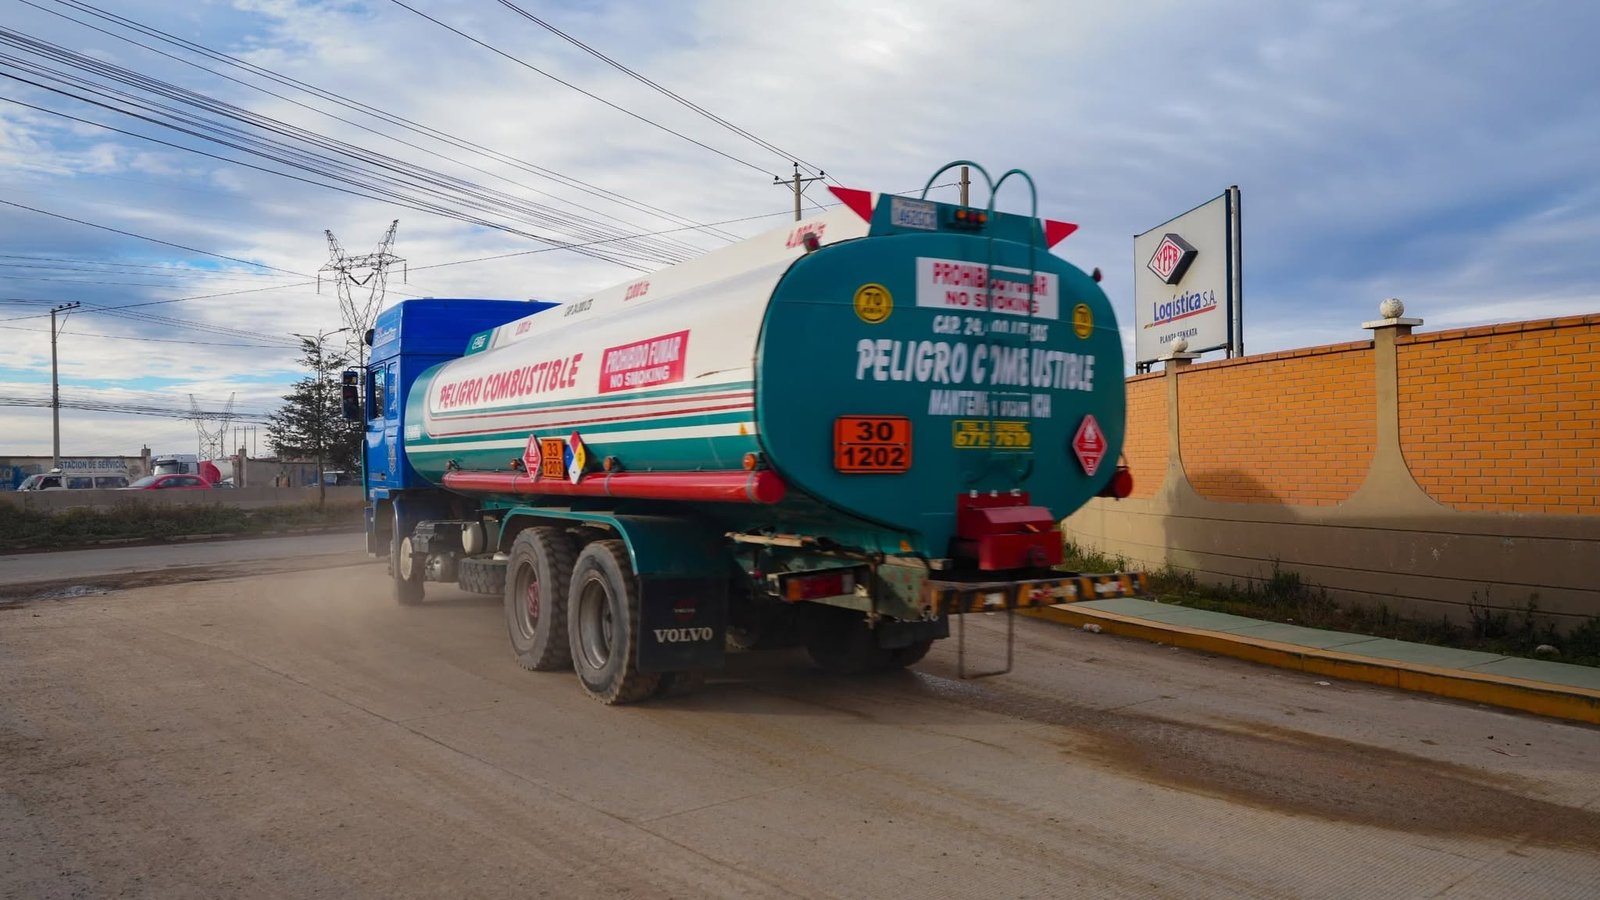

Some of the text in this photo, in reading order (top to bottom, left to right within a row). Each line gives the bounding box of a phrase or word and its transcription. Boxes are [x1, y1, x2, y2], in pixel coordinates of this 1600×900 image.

[1155, 243, 1179, 273] YPFB
[864, 291, 883, 306] 70
[945, 291, 969, 306] NO
[1153, 290, 1202, 323] Logística
[605, 336, 682, 374] PROHIBIDO FUMAR
[856, 337, 968, 384] PELIGRO
[439, 352, 583, 409] PELIGRO COMBUSTIBLE
[610, 365, 670, 388] NO SMOKING
[855, 421, 894, 442] 30
[547, 442, 558, 457] 33
[843, 446, 904, 467] 1202
[58, 460, 87, 469] STACION
[88, 460, 97, 469] DE
[545, 460, 562, 476] 1203
[654, 626, 713, 644] VOLVO
